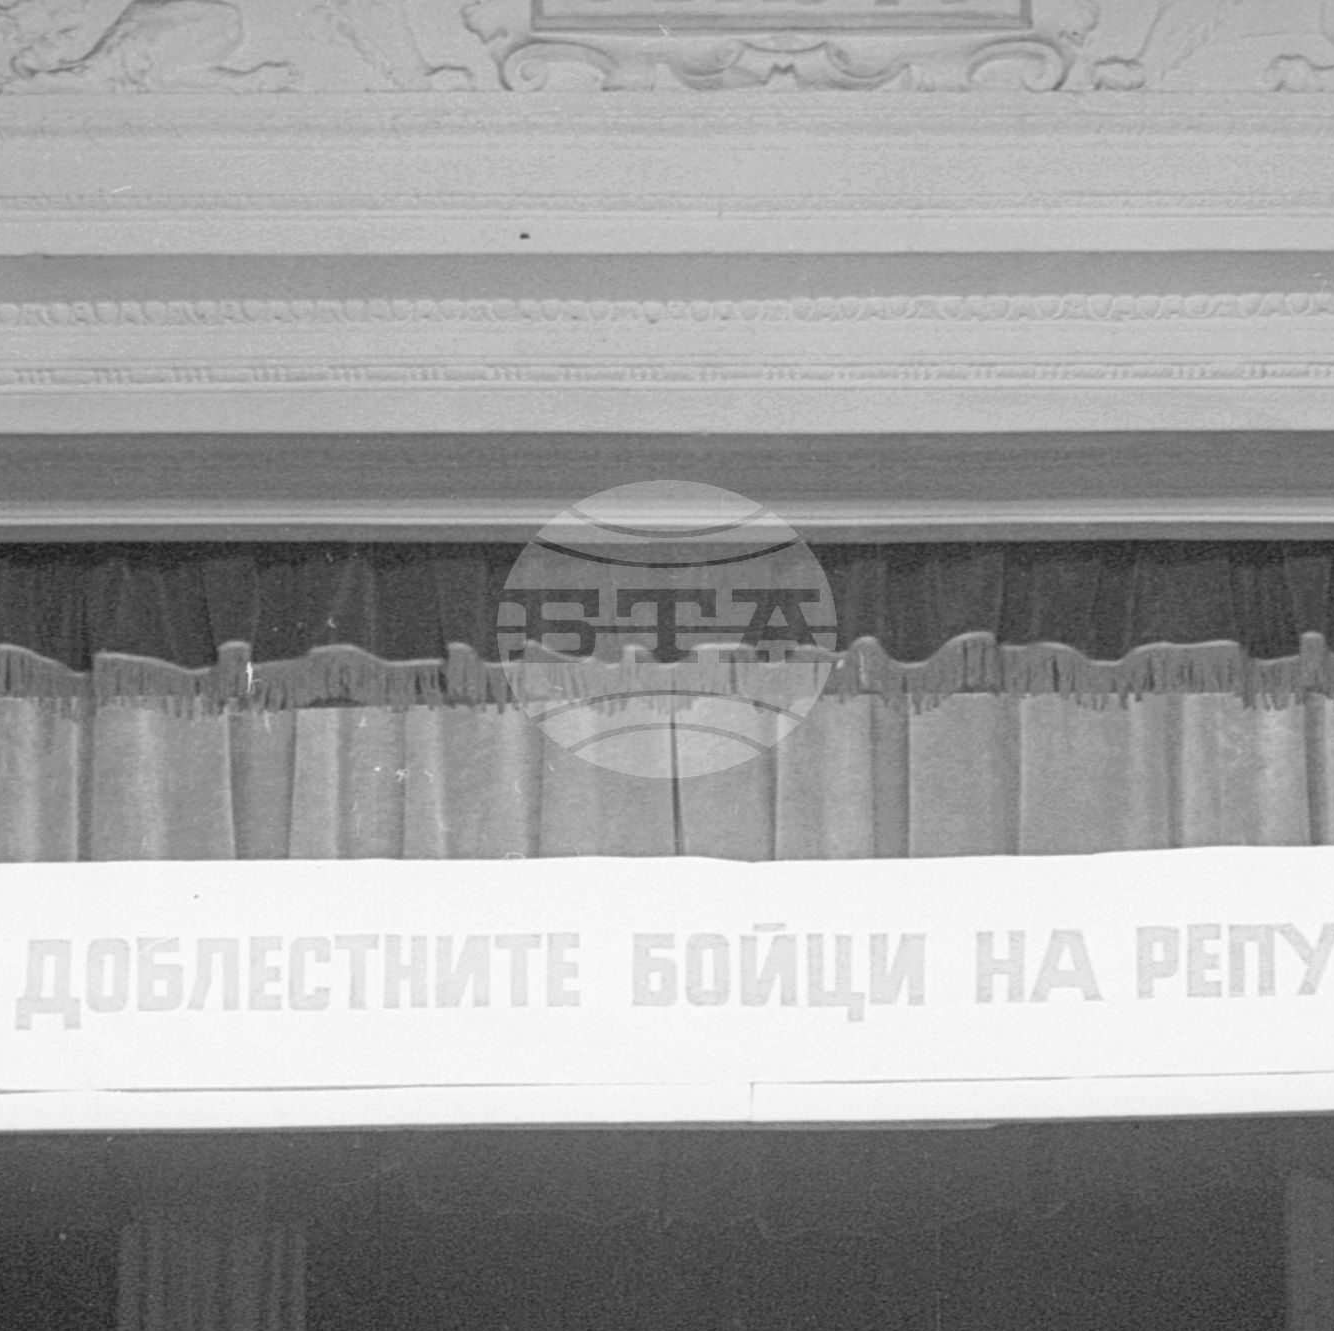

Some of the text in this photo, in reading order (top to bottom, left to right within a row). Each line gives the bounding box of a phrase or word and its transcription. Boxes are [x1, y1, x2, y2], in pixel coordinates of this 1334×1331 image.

[14, 931, 581, 1031] ДОБЛЕСТНИТЕ
[632, 921, 926, 1024] БОЙЦИ
[974, 928, 1104, 1004] НА
